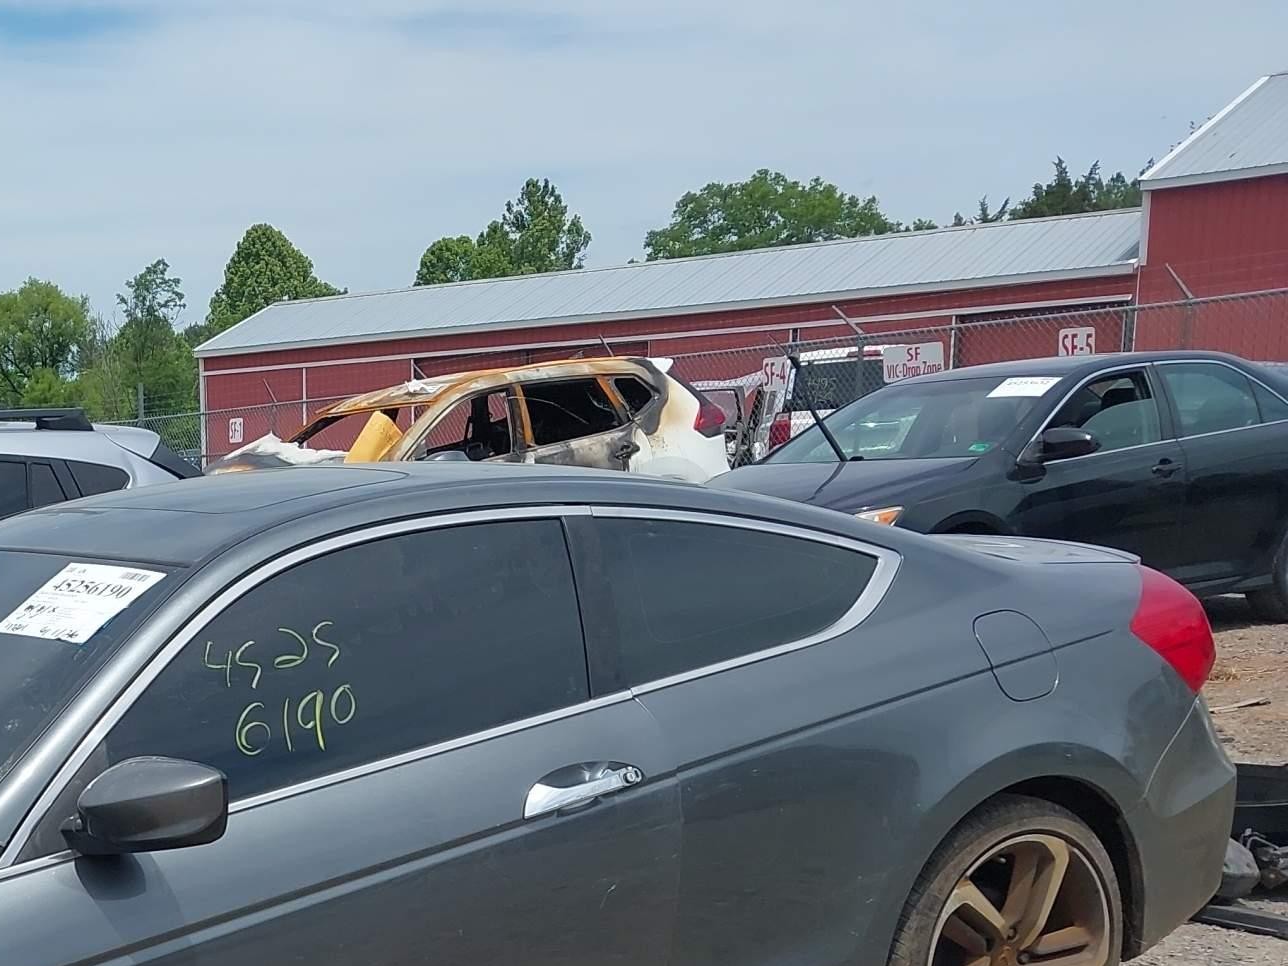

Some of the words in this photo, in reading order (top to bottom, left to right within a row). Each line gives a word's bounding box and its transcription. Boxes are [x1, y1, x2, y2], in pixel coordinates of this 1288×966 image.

[906, 347, 921, 362] SF
[1062, 333, 1093, 356] SF-5
[763, 360, 786, 386] SF-4
[887, 363, 921, 378] VIC-Drop
[922, 361, 942, 375] Zone
[230, 421, 242, 439] SF-1
[52, 578, 133, 599] 45256190
[203, 620, 341, 690] 4525
[234, 683, 357, 757] 6190
